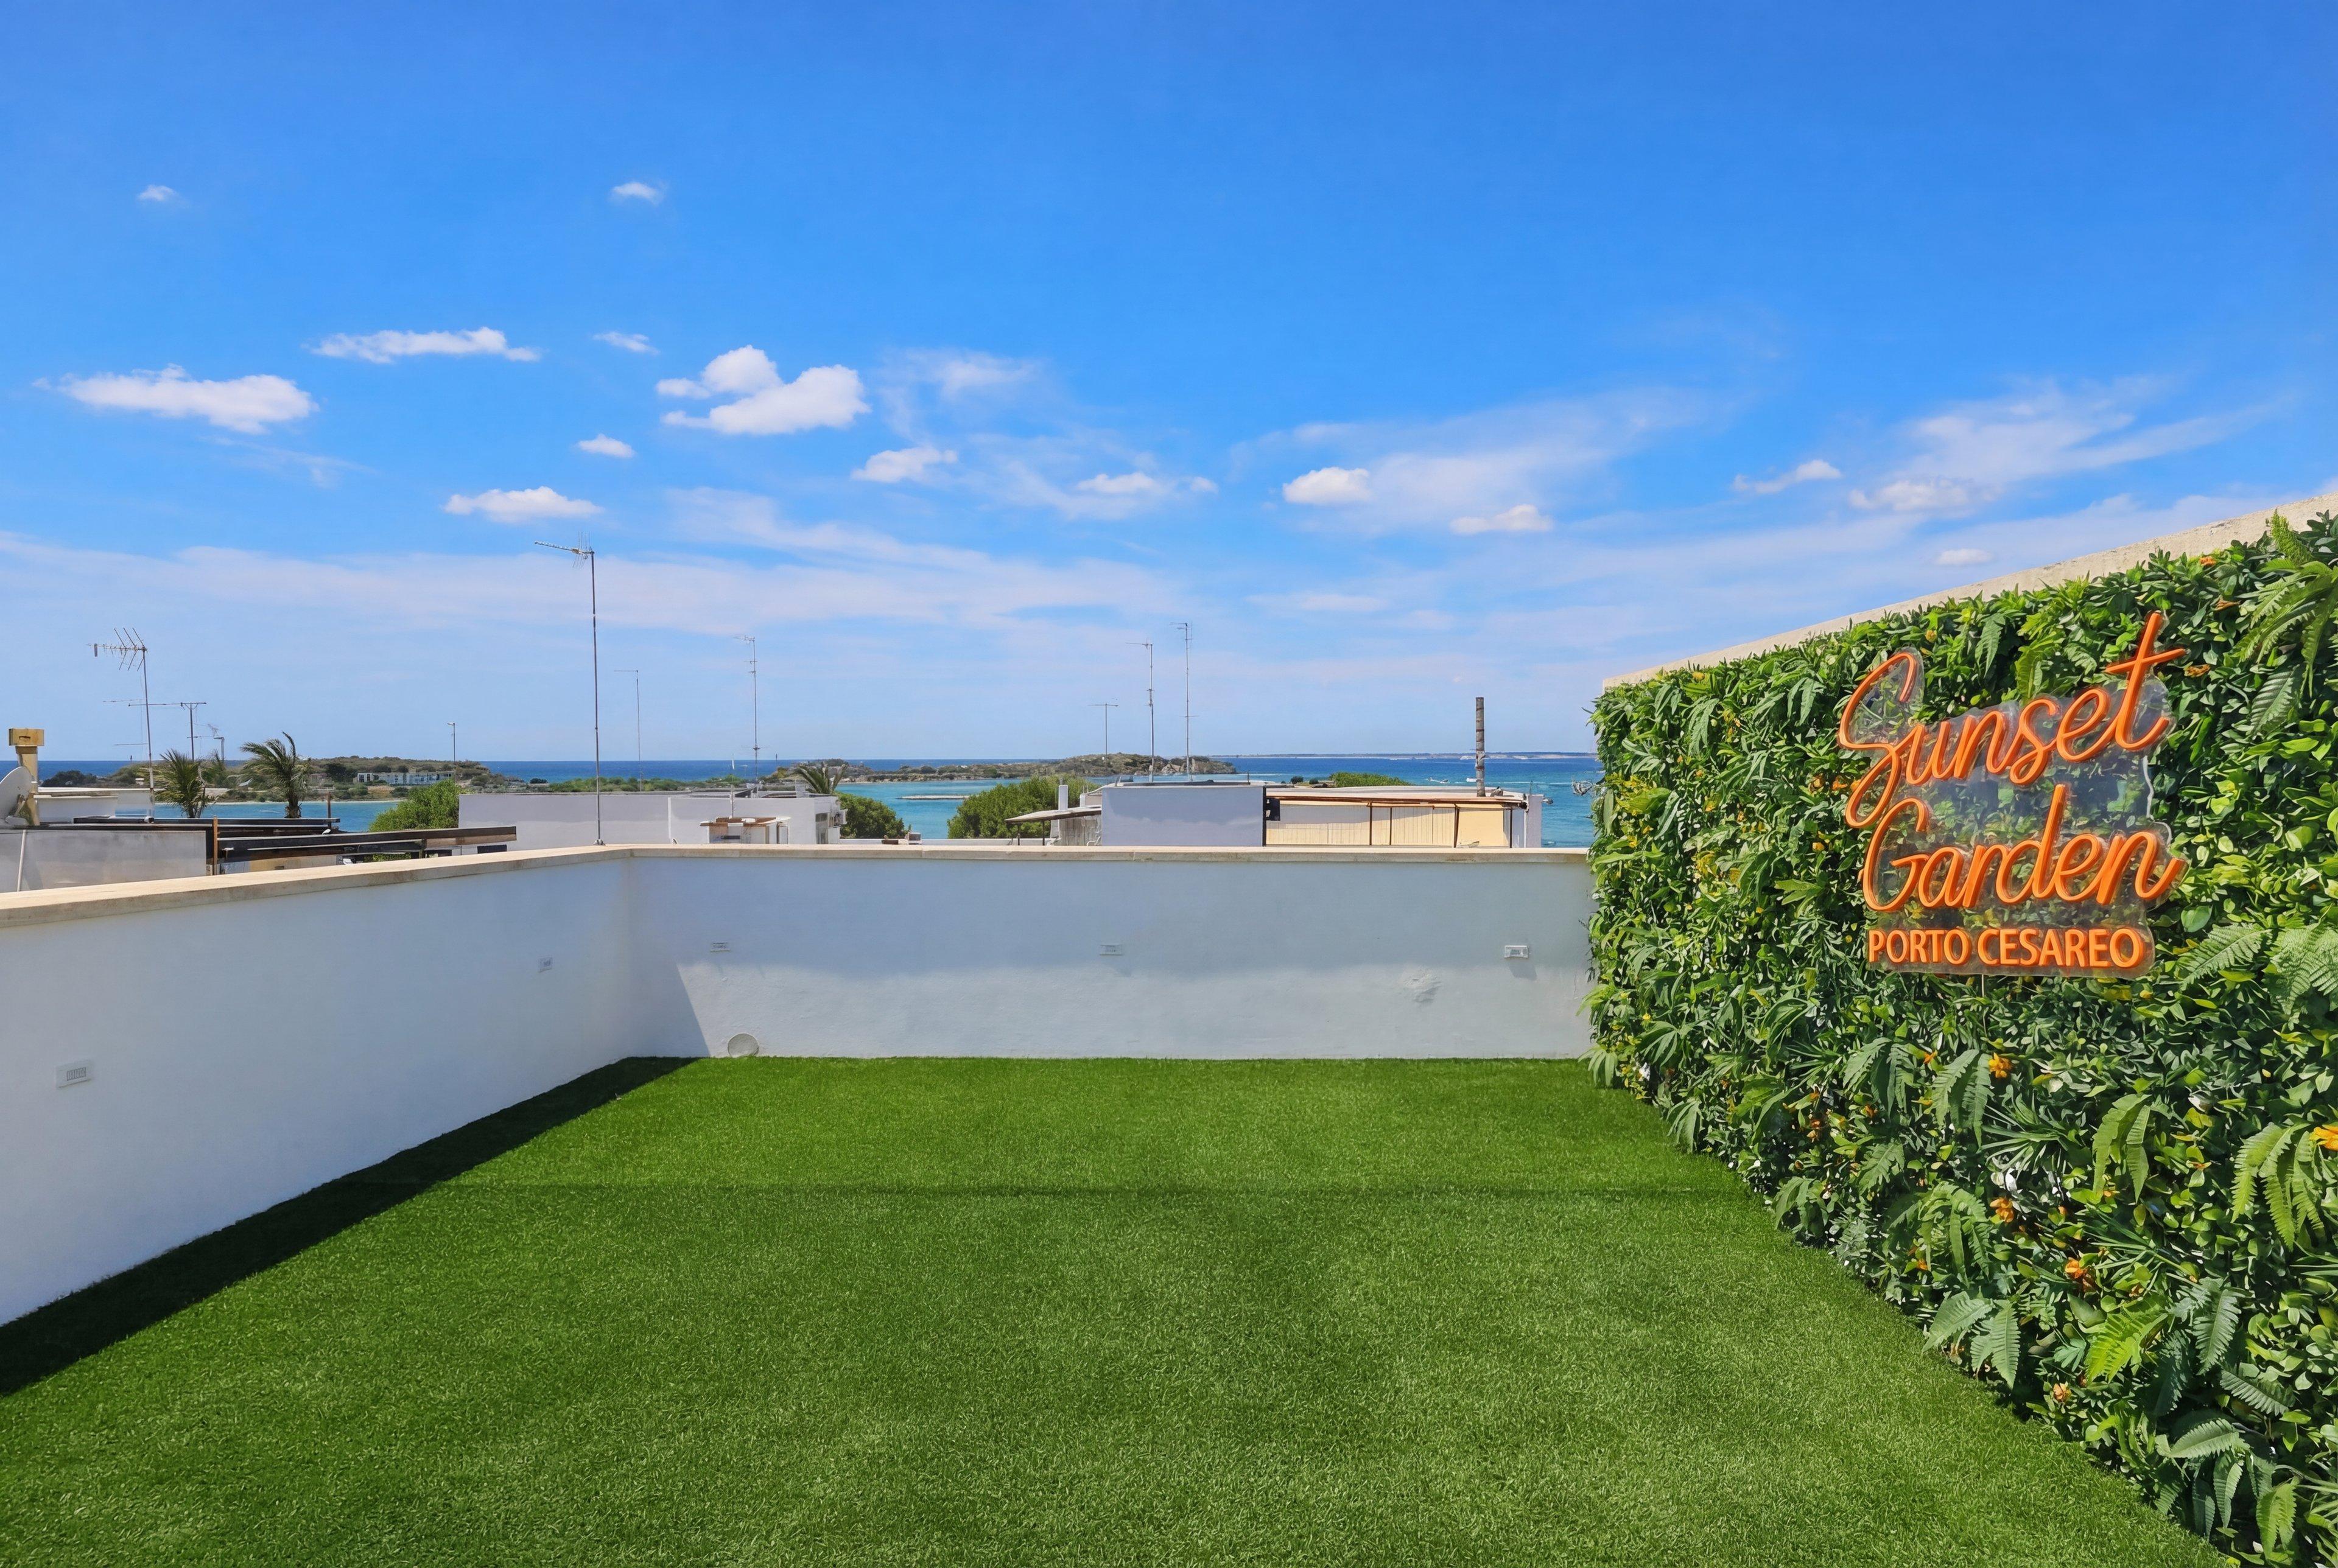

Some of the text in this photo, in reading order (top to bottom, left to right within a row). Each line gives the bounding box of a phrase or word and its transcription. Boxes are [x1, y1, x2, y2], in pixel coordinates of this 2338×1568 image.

[1839, 611, 2186, 828] Sunset
[1861, 783, 2188, 912] Garden
[1868, 928, 2145, 968] PORTO CESAREO
